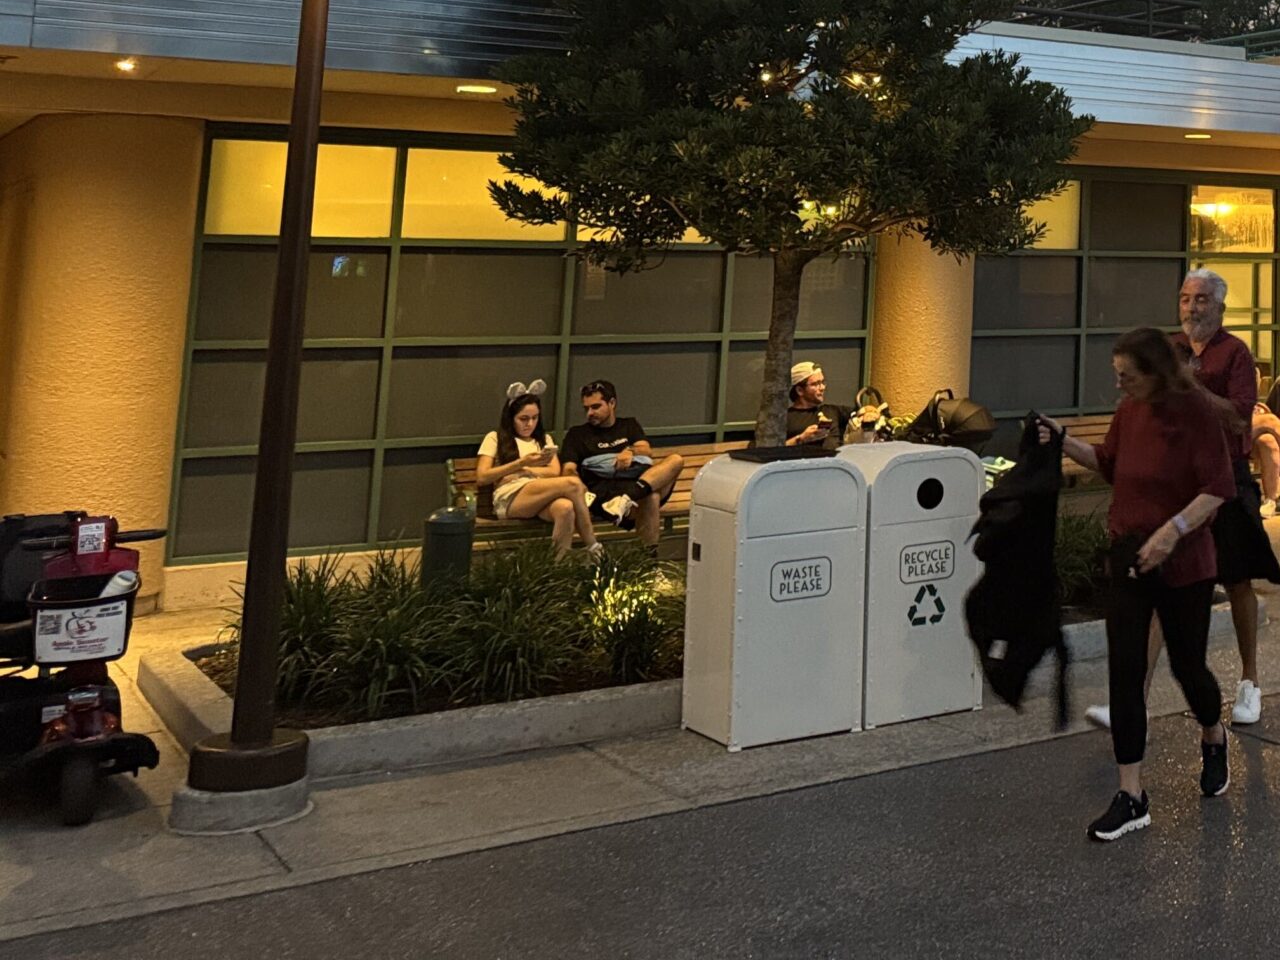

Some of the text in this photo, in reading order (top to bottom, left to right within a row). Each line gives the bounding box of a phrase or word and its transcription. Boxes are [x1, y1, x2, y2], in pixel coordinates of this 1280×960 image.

[904, 547, 951, 565] RECYCLE
[781, 565, 821, 581] WASTE
[908, 561, 946, 577] PLEASE
[779, 578, 823, 595] PLEASE
